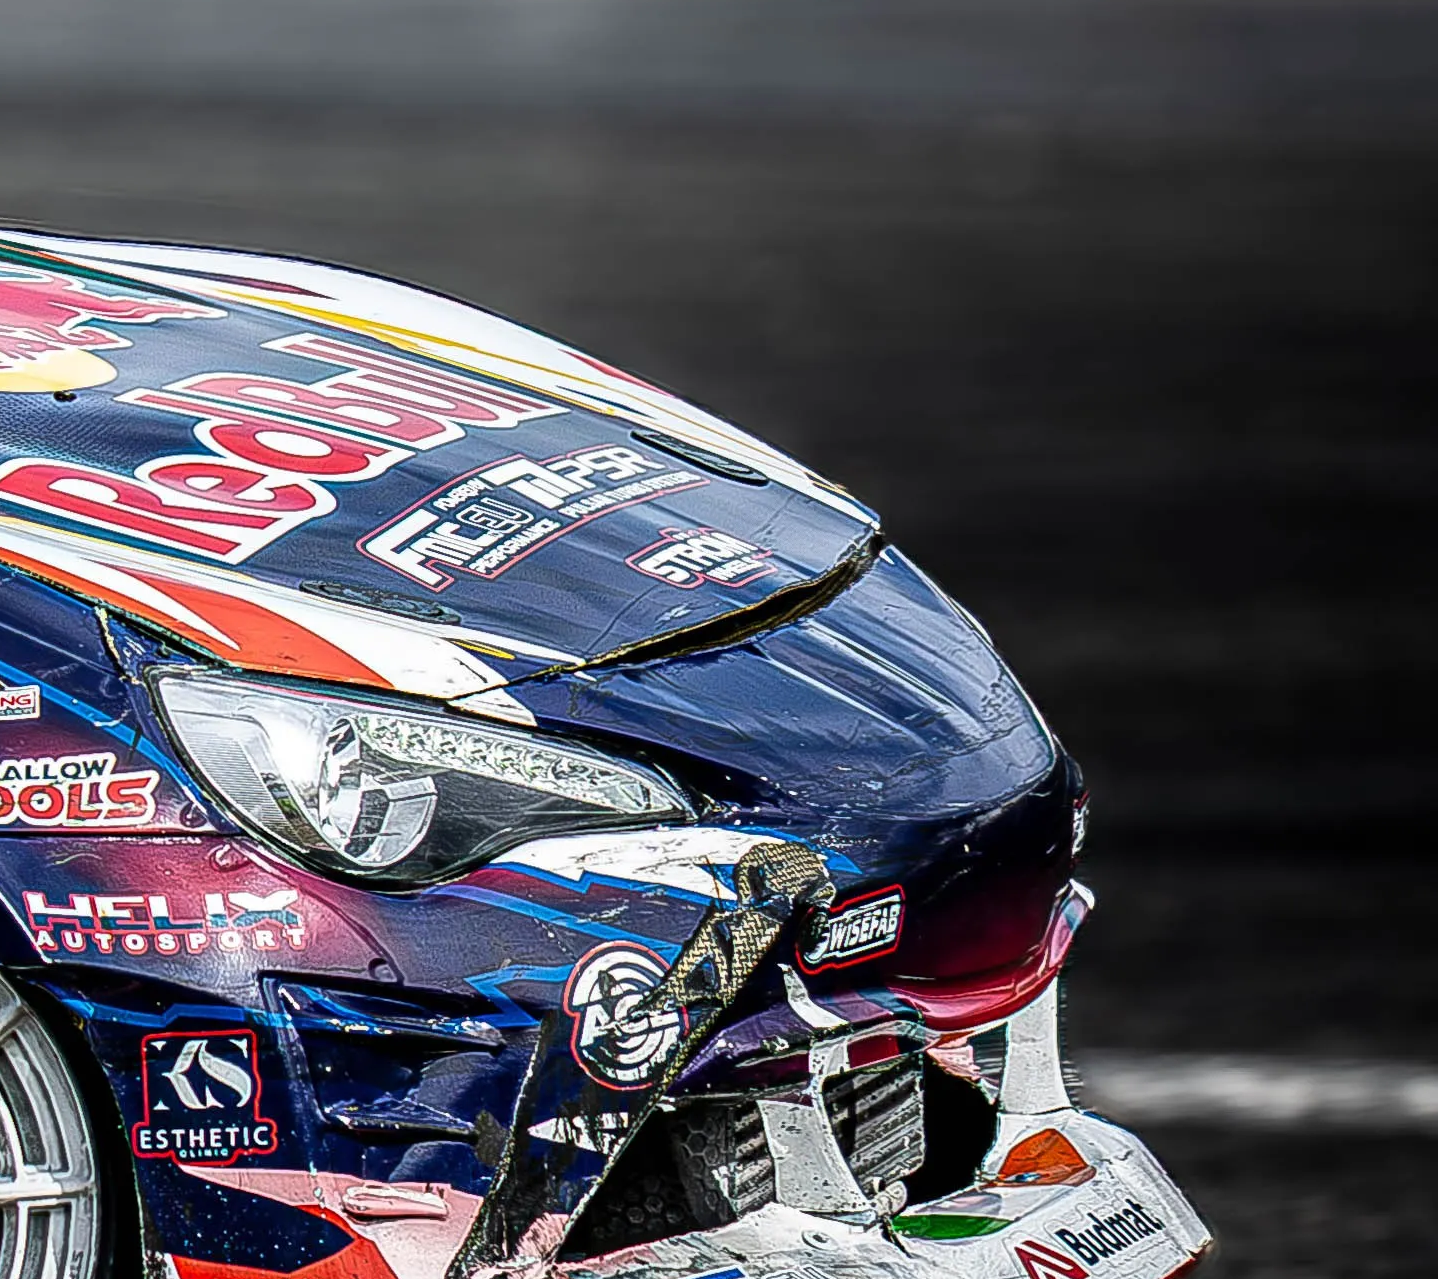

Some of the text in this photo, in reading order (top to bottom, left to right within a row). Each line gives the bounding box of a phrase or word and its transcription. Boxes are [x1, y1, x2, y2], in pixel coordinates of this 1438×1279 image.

[210, 337, 552, 444] Bull
[24, 889, 301, 929] HELIX
[36, 929, 305, 951] AUTOSPORT
[140, 1126, 269, 1149] ESTHETIC
[1054, 1198, 1166, 1267] Budmat
